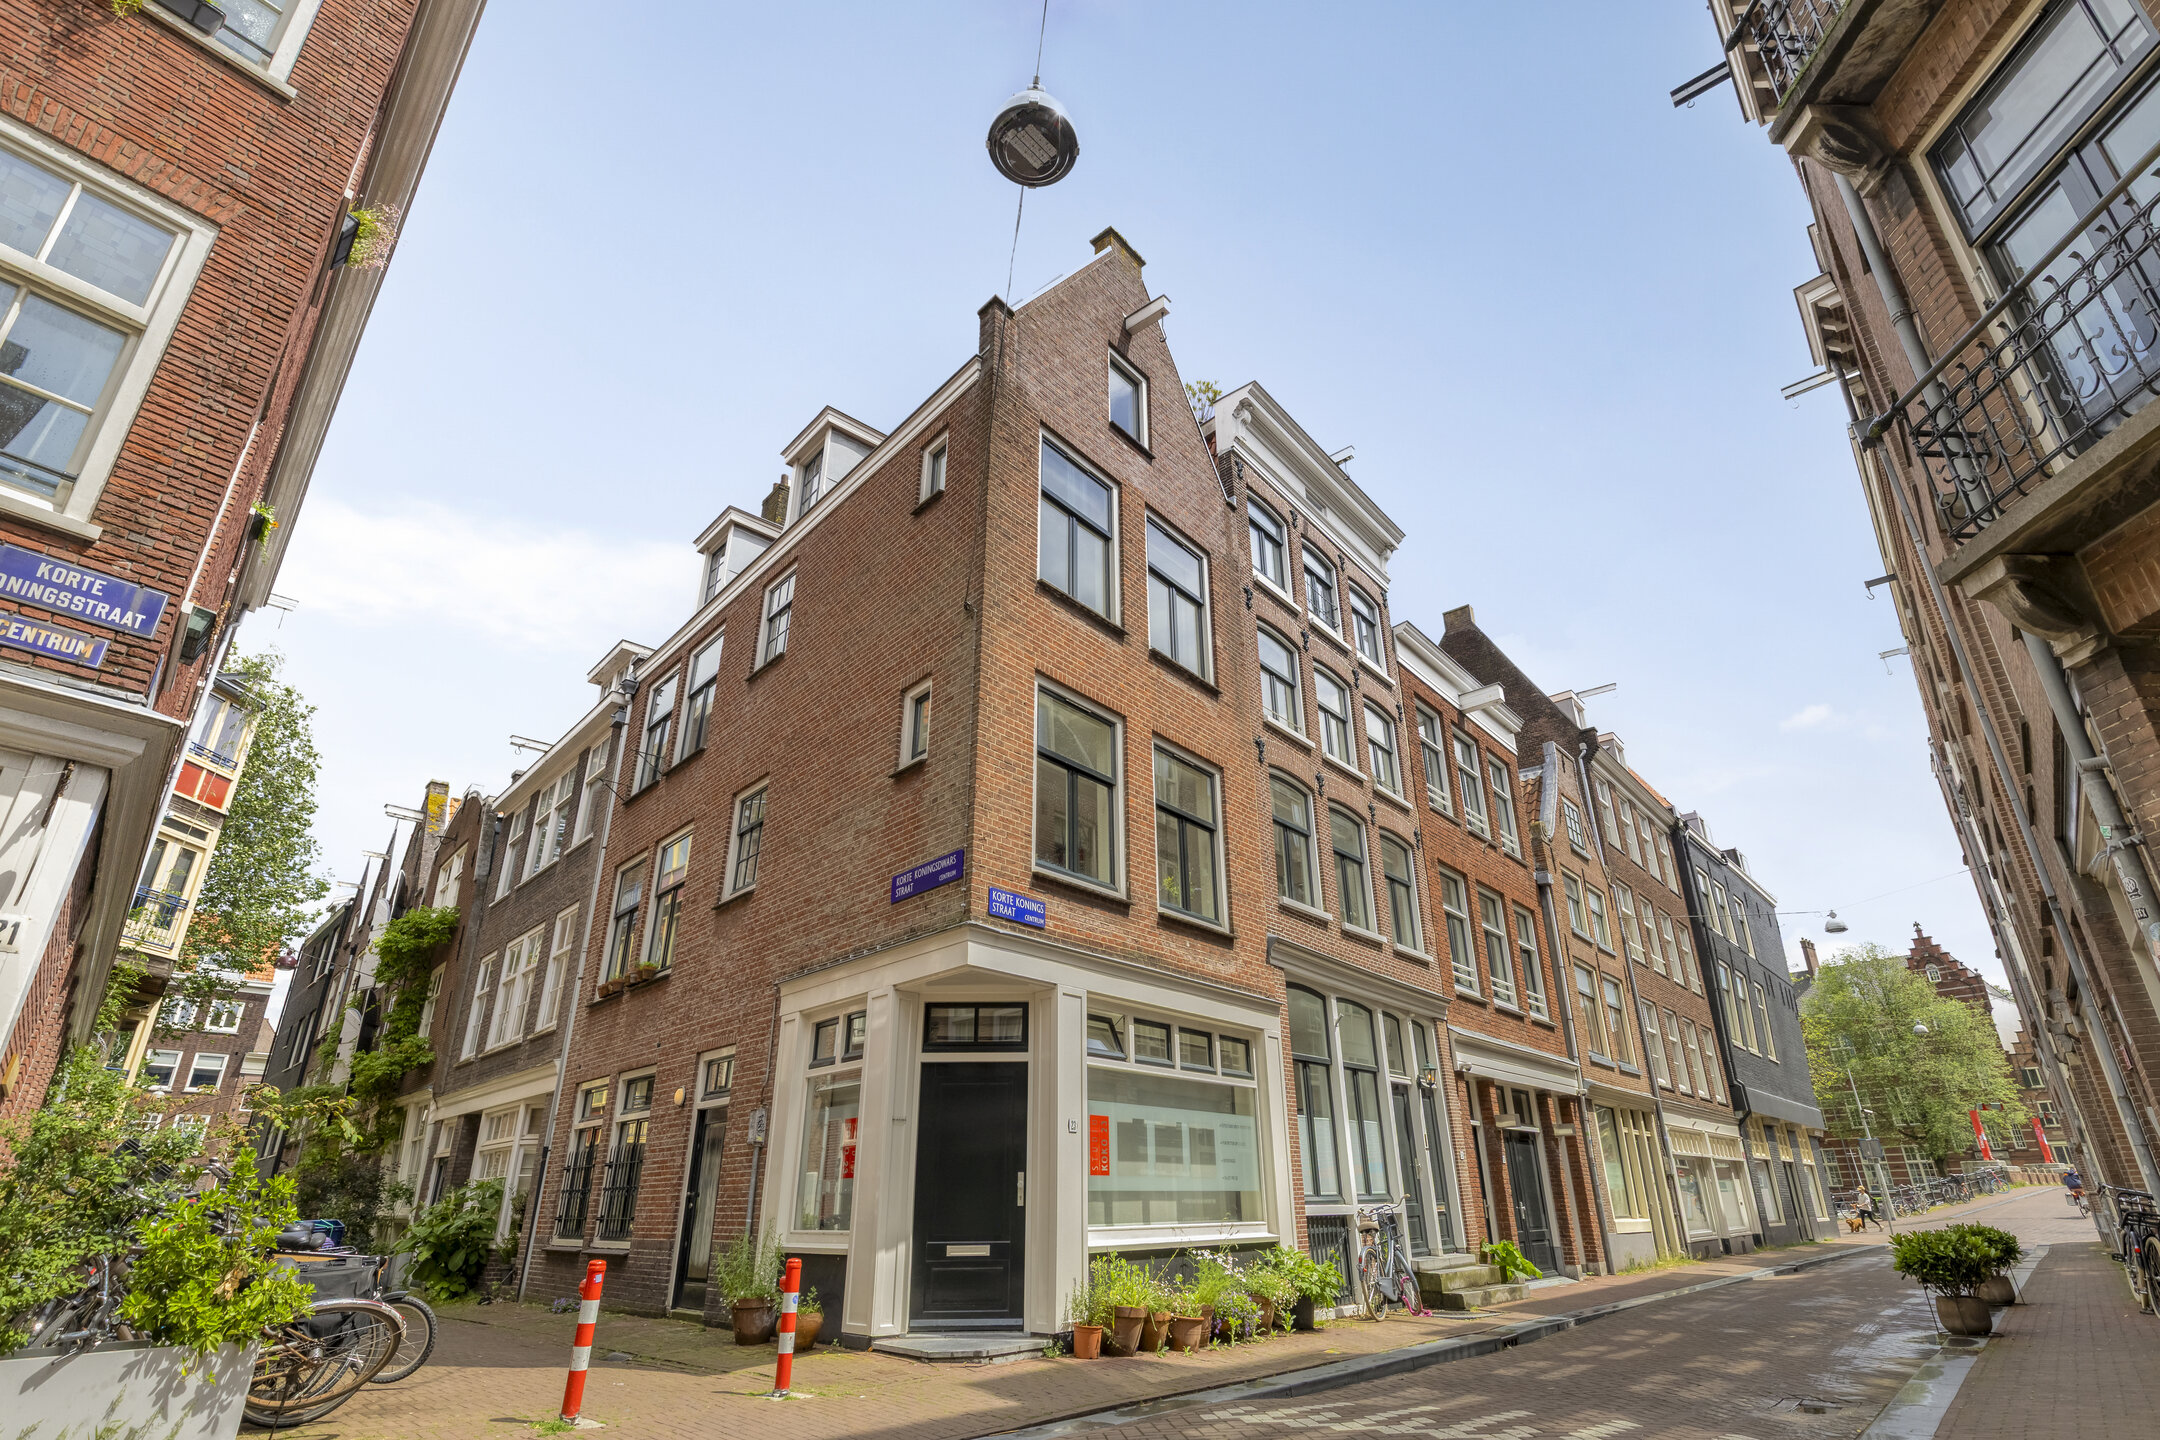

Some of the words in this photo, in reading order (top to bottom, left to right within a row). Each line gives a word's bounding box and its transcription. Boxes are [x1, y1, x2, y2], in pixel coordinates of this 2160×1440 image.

[36, 562, 107, 596] KORTE
[0, 618, 94, 659] CENTRUM
[896, 872, 913, 887] KORTE
[914, 854, 957, 880] KONINGSDWARS
[938, 869, 957, 881] CENTRUM
[895, 882, 914, 898] STRAAT
[992, 890, 1014, 905] KORTE
[1015, 897, 1044, 914] KONINGS
[992, 902, 1016, 917] STRAAT
[1024, 914, 1045, 925] CENTRUM
[1102, 1120, 1108, 1132] 23
